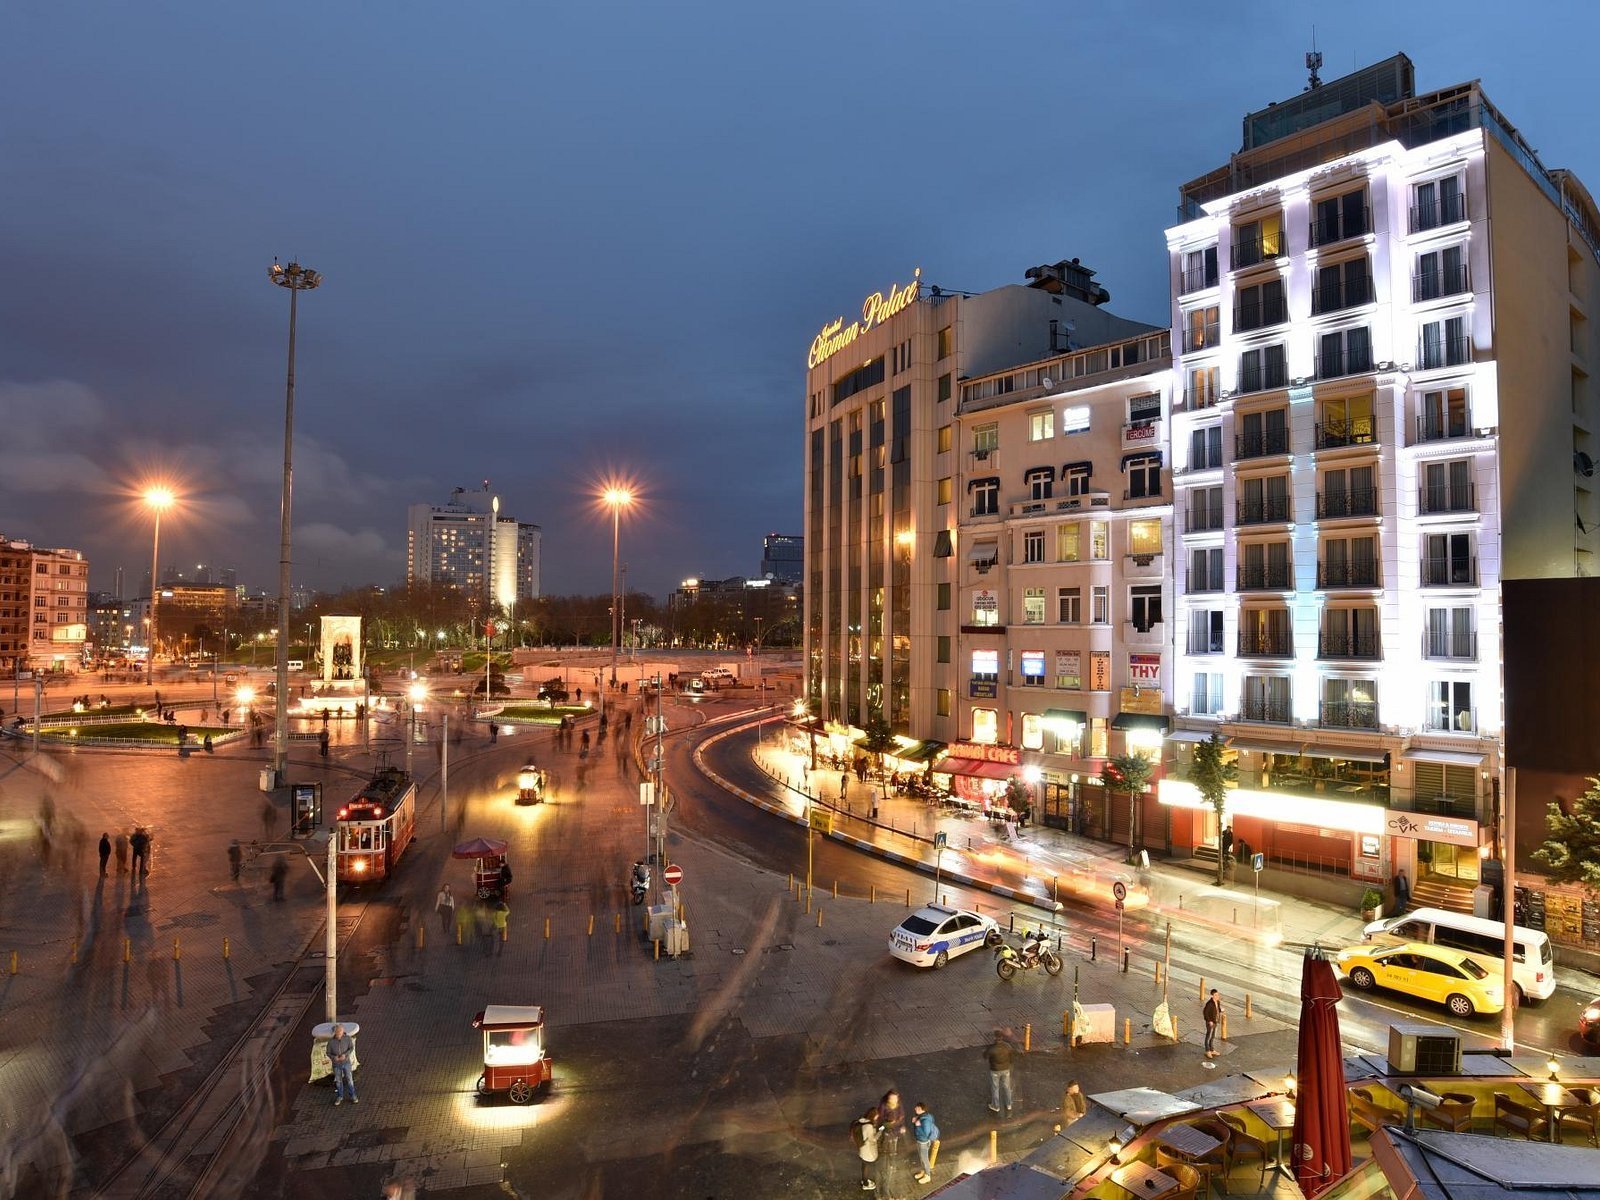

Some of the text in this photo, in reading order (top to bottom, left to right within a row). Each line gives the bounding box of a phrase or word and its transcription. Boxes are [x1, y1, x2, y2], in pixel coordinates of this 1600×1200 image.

[808, 321, 859, 369] Ottoman
[861, 281, 918, 334] Palace
[1130, 665, 1160, 678] THY
[1388, 820, 1418, 834] CVK
